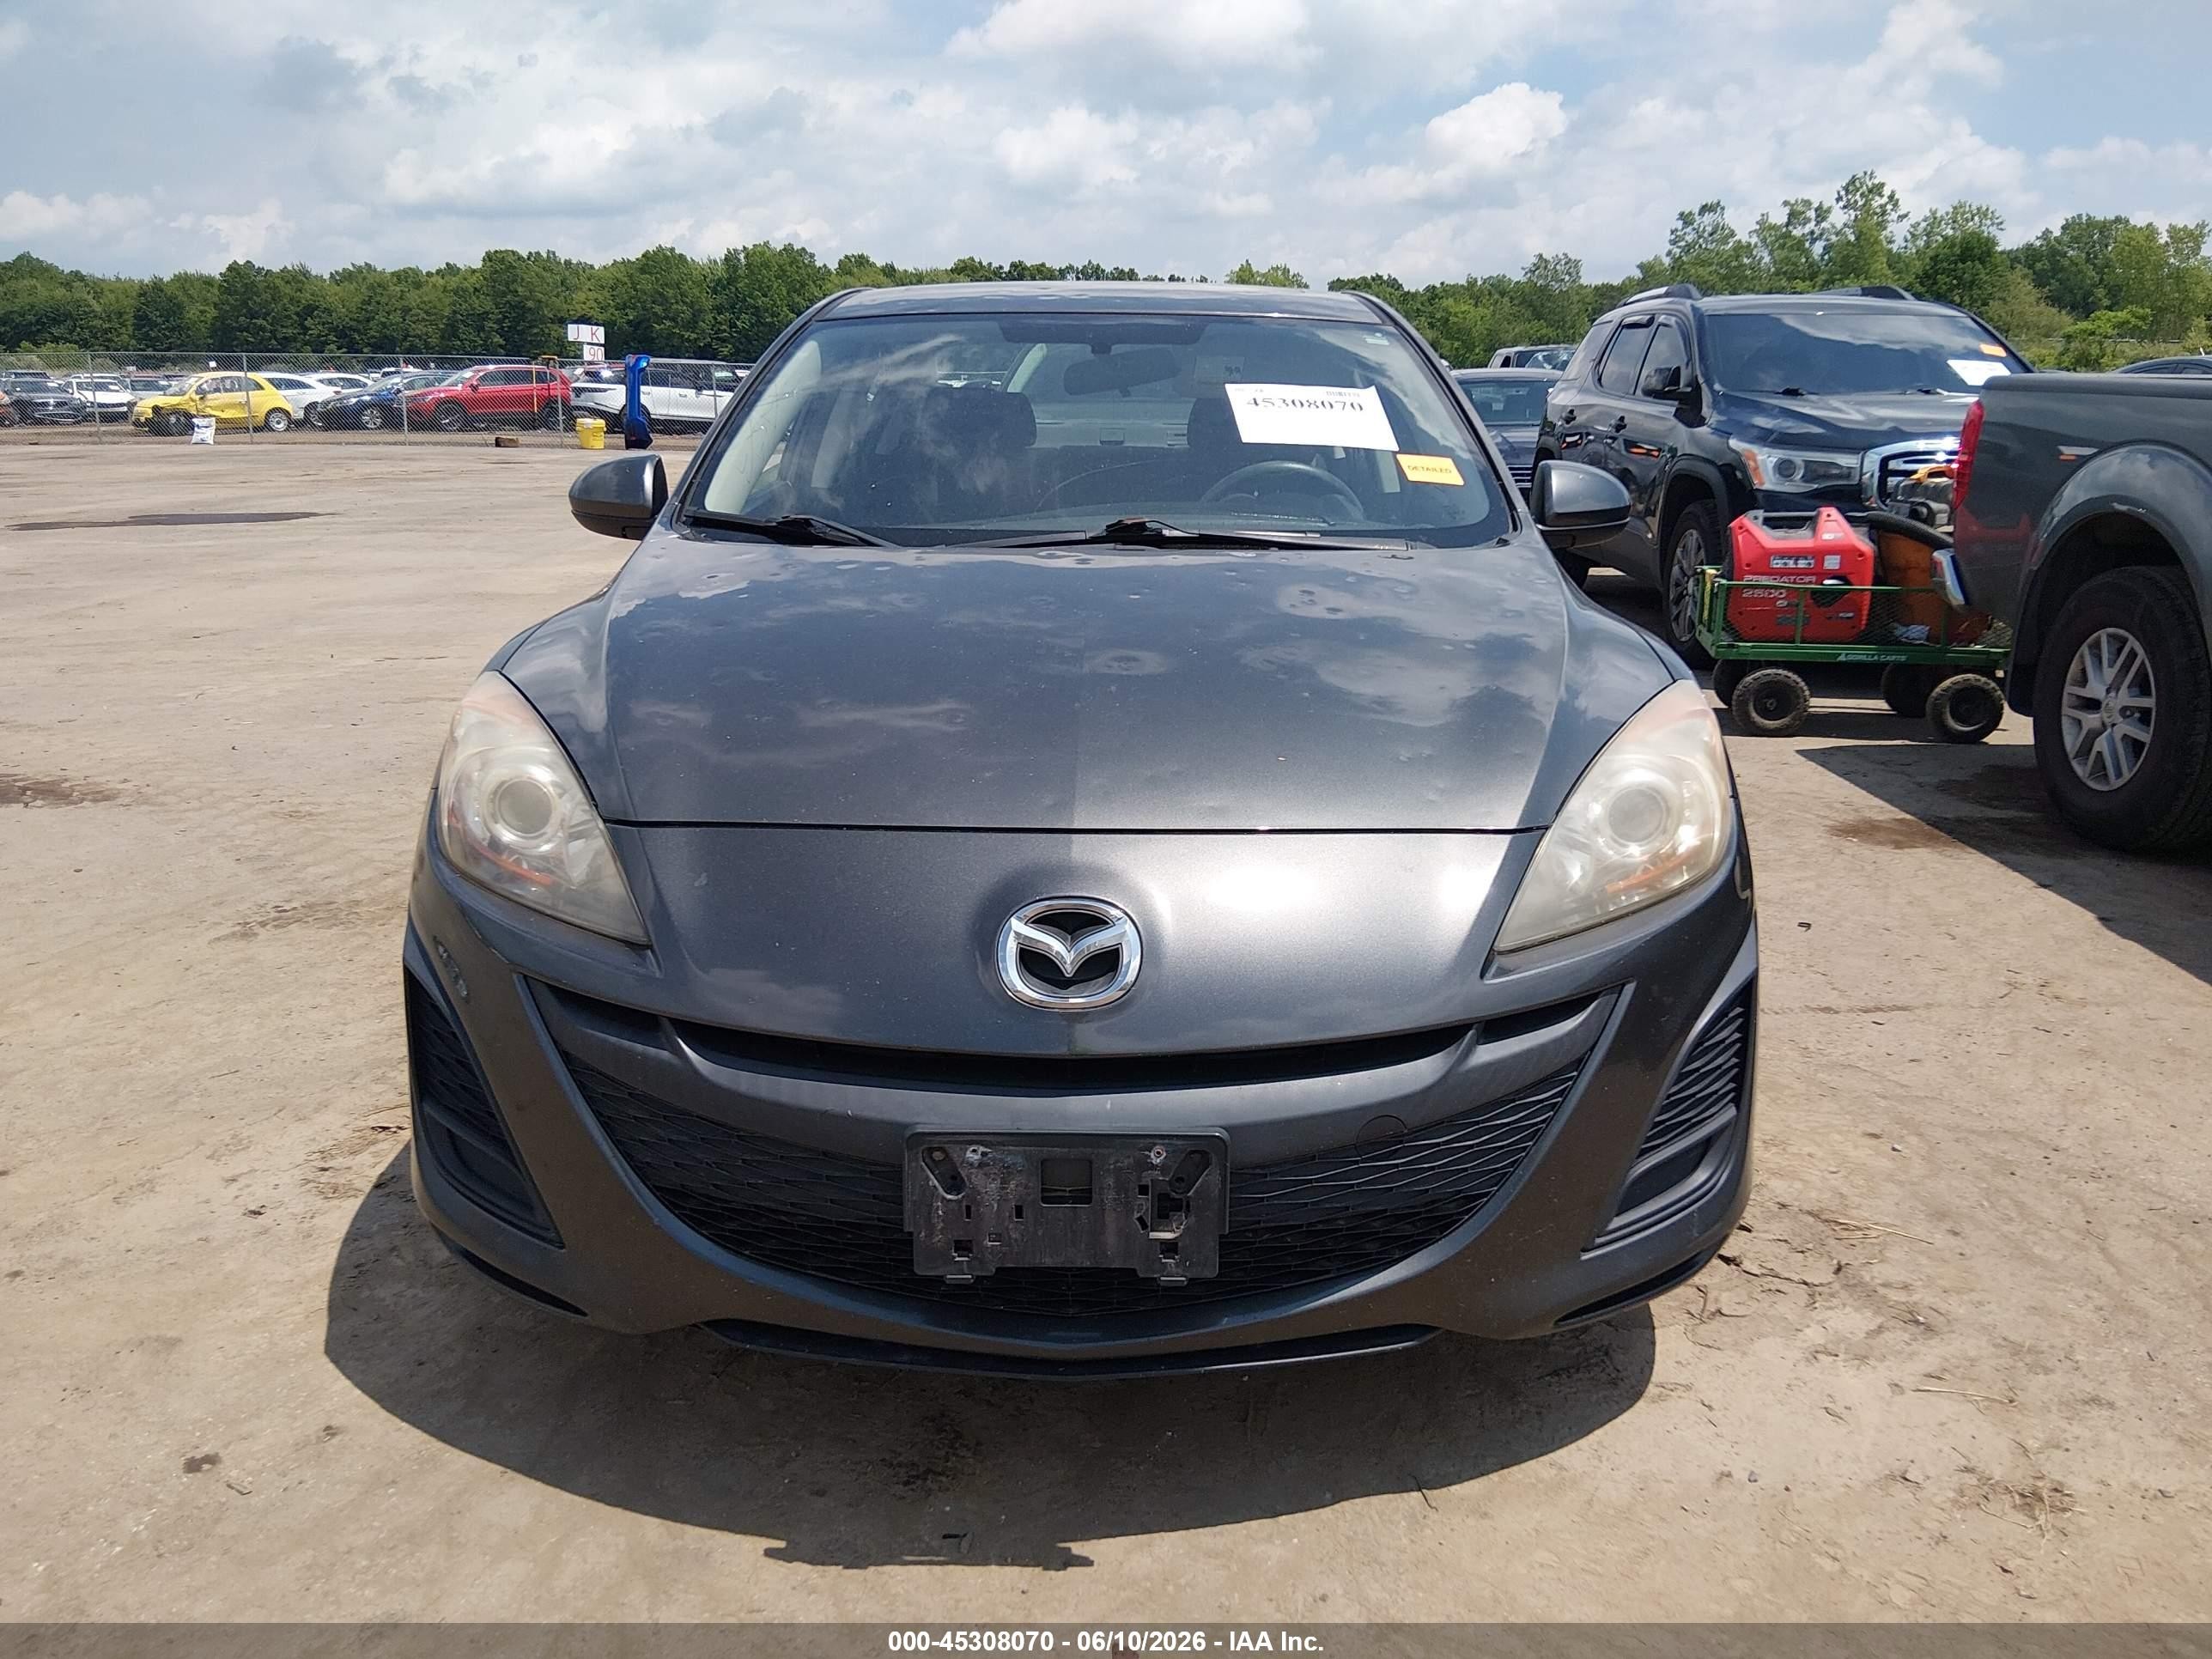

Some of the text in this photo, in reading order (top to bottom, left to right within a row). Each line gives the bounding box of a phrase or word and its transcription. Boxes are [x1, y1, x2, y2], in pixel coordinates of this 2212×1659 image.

[573, 325, 601, 343] J K
[1247, 397, 1364, 412] 45308070
[1742, 574, 1817, 583] PREDATOR
